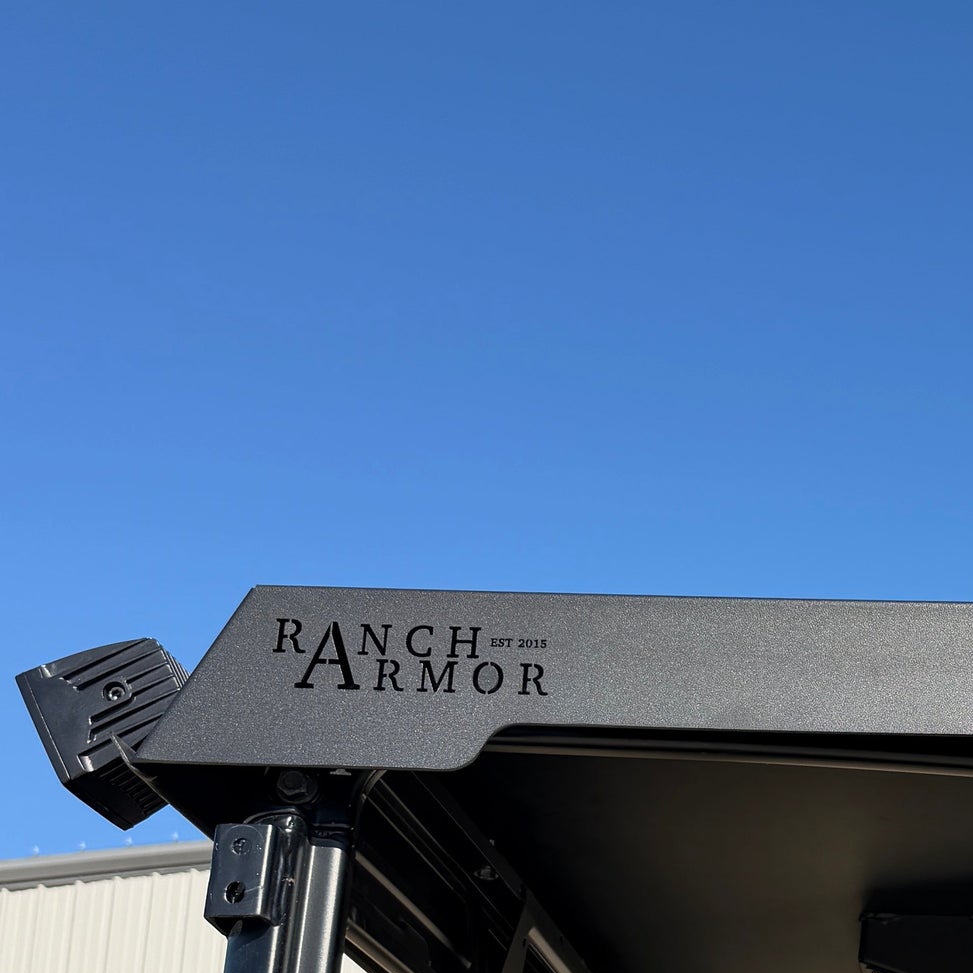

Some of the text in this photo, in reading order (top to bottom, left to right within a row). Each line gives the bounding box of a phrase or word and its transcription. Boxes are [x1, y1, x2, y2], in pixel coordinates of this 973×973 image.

[272, 617, 482, 690] RANCH
[490, 637, 547, 649] EST 2015
